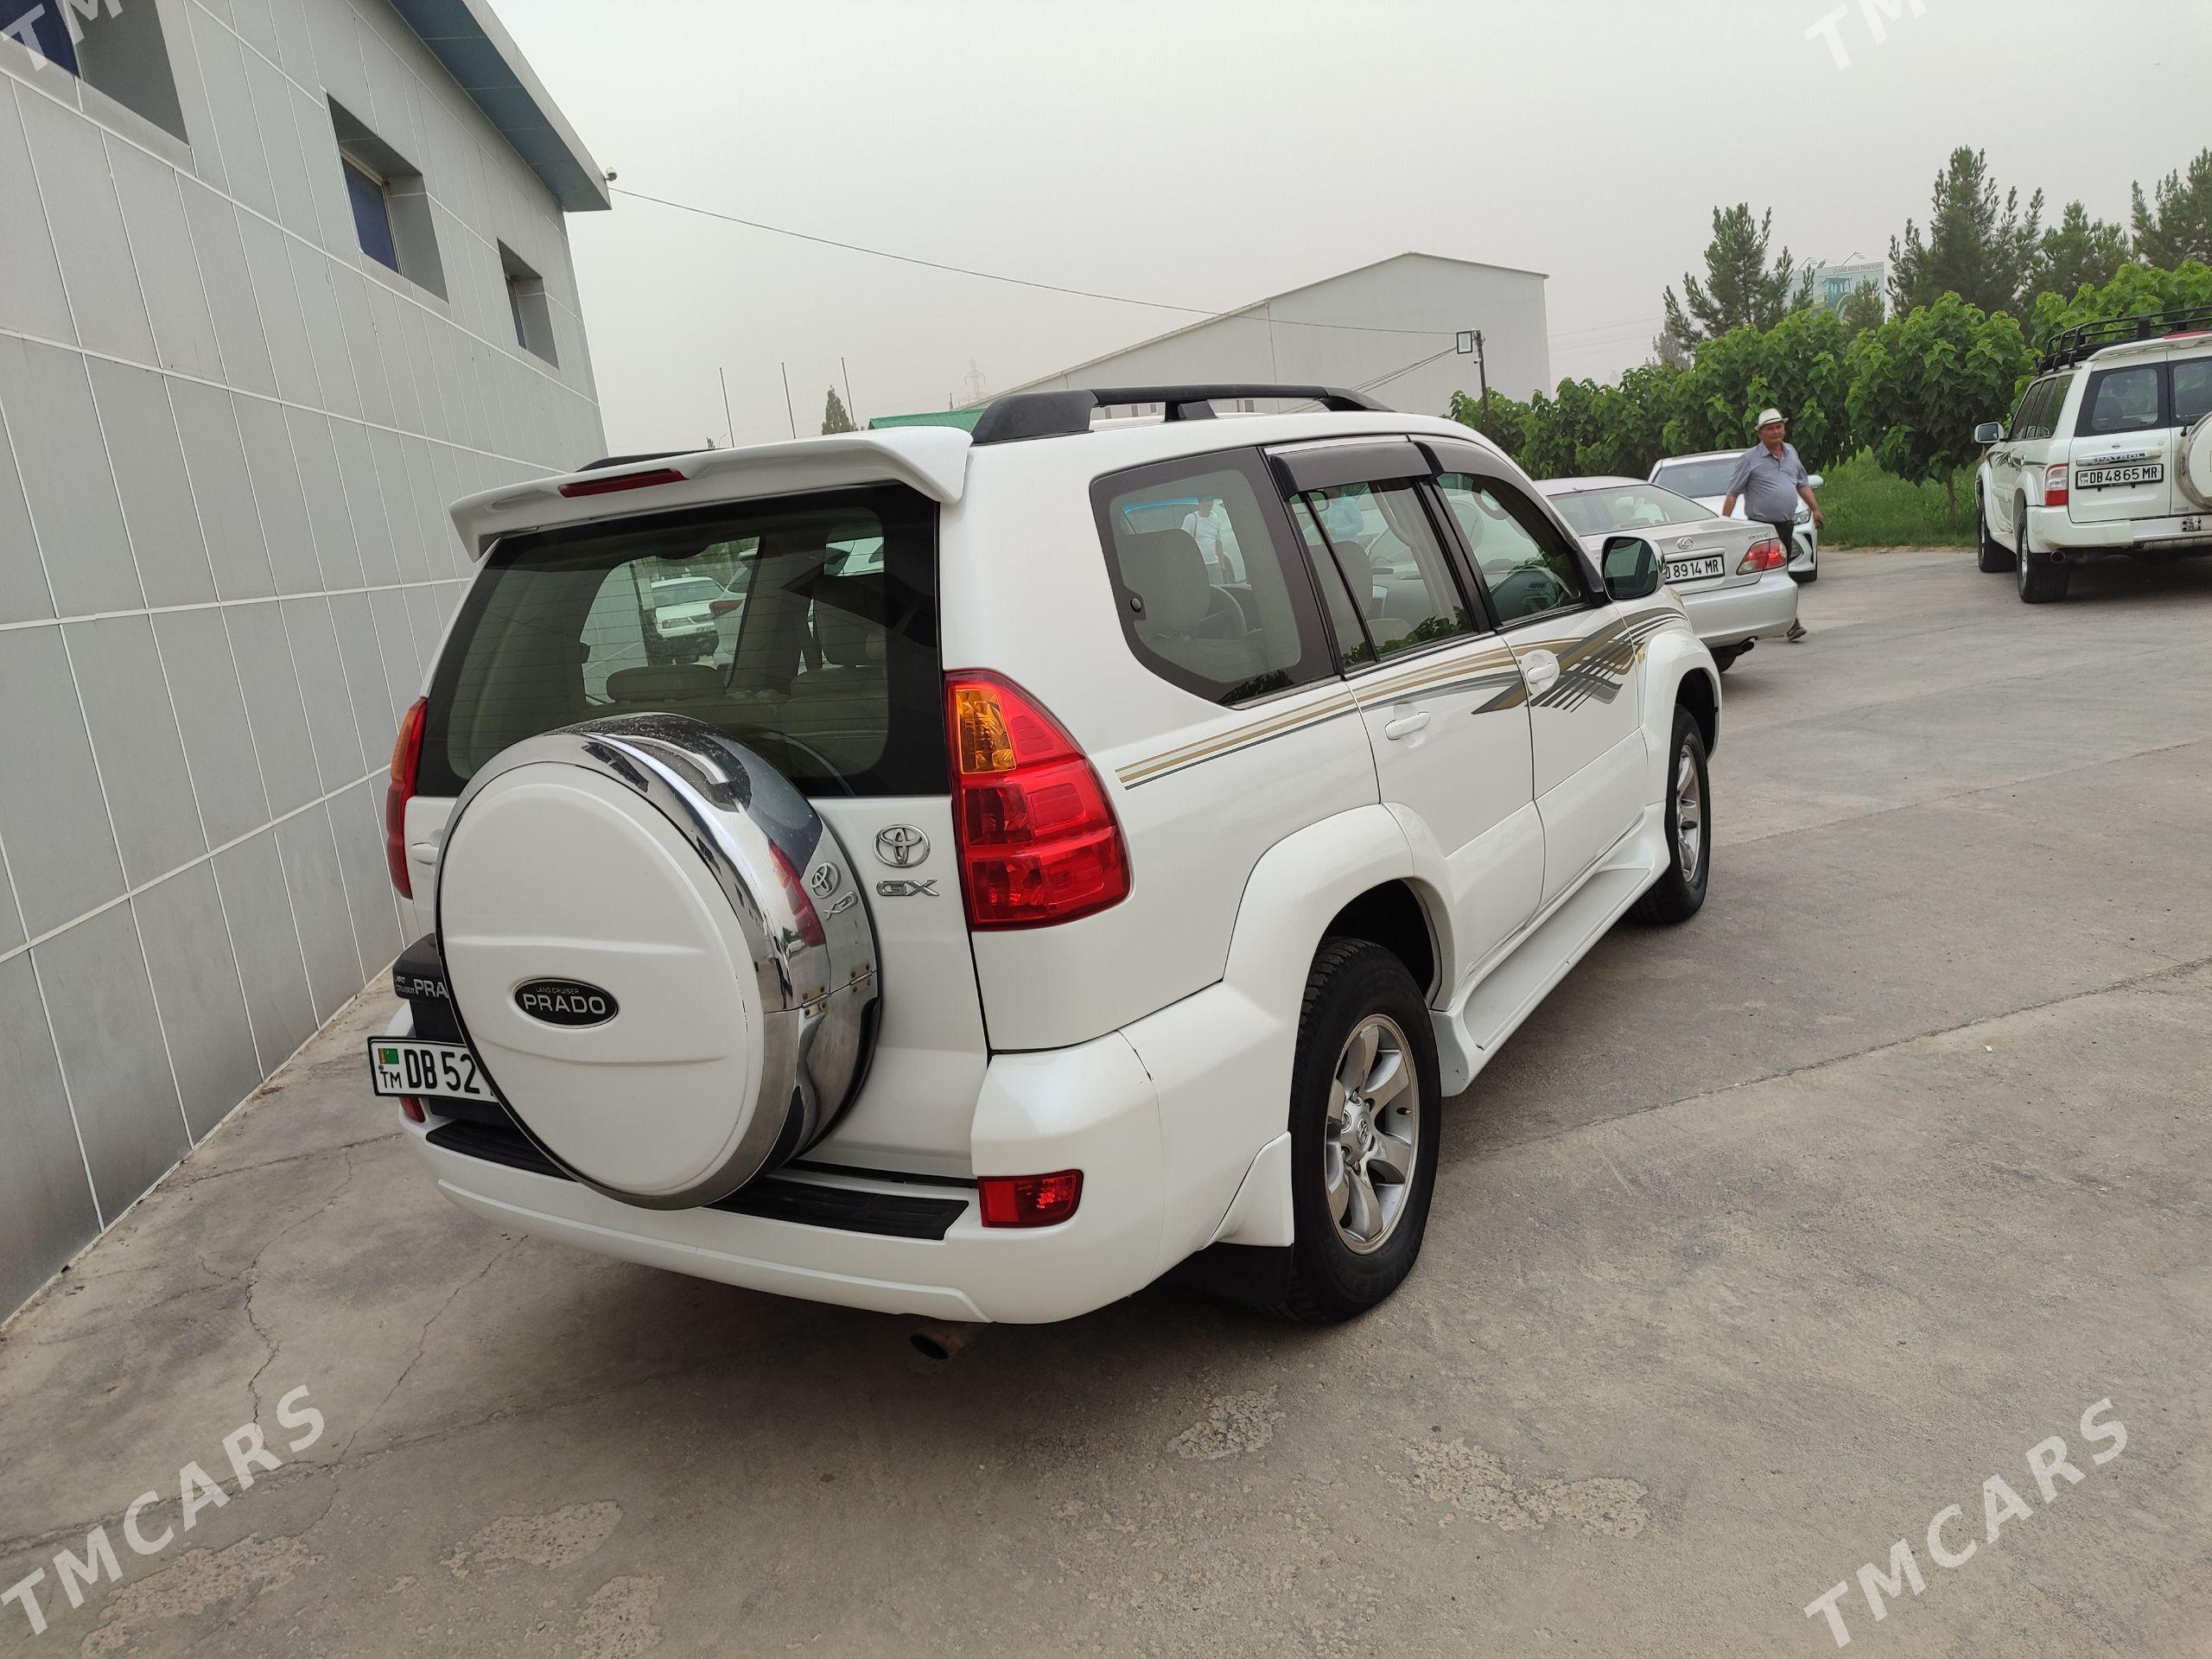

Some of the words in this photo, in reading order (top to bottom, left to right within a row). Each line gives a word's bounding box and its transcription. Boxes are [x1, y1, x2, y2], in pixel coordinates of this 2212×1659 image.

[2089, 471, 2103, 484] DB
[2105, 467, 2140, 482] 4865
[2142, 467, 2158, 480] MR
[1673, 561, 1702, 578] 8914
[1705, 559, 1719, 574] MR
[875, 879, 940, 897] GX
[522, 993, 606, 1014] PRADO
[379, 1071, 403, 1089] TM
[404, 1048, 438, 1090] DB
[440, 1051, 494, 1096] 52
